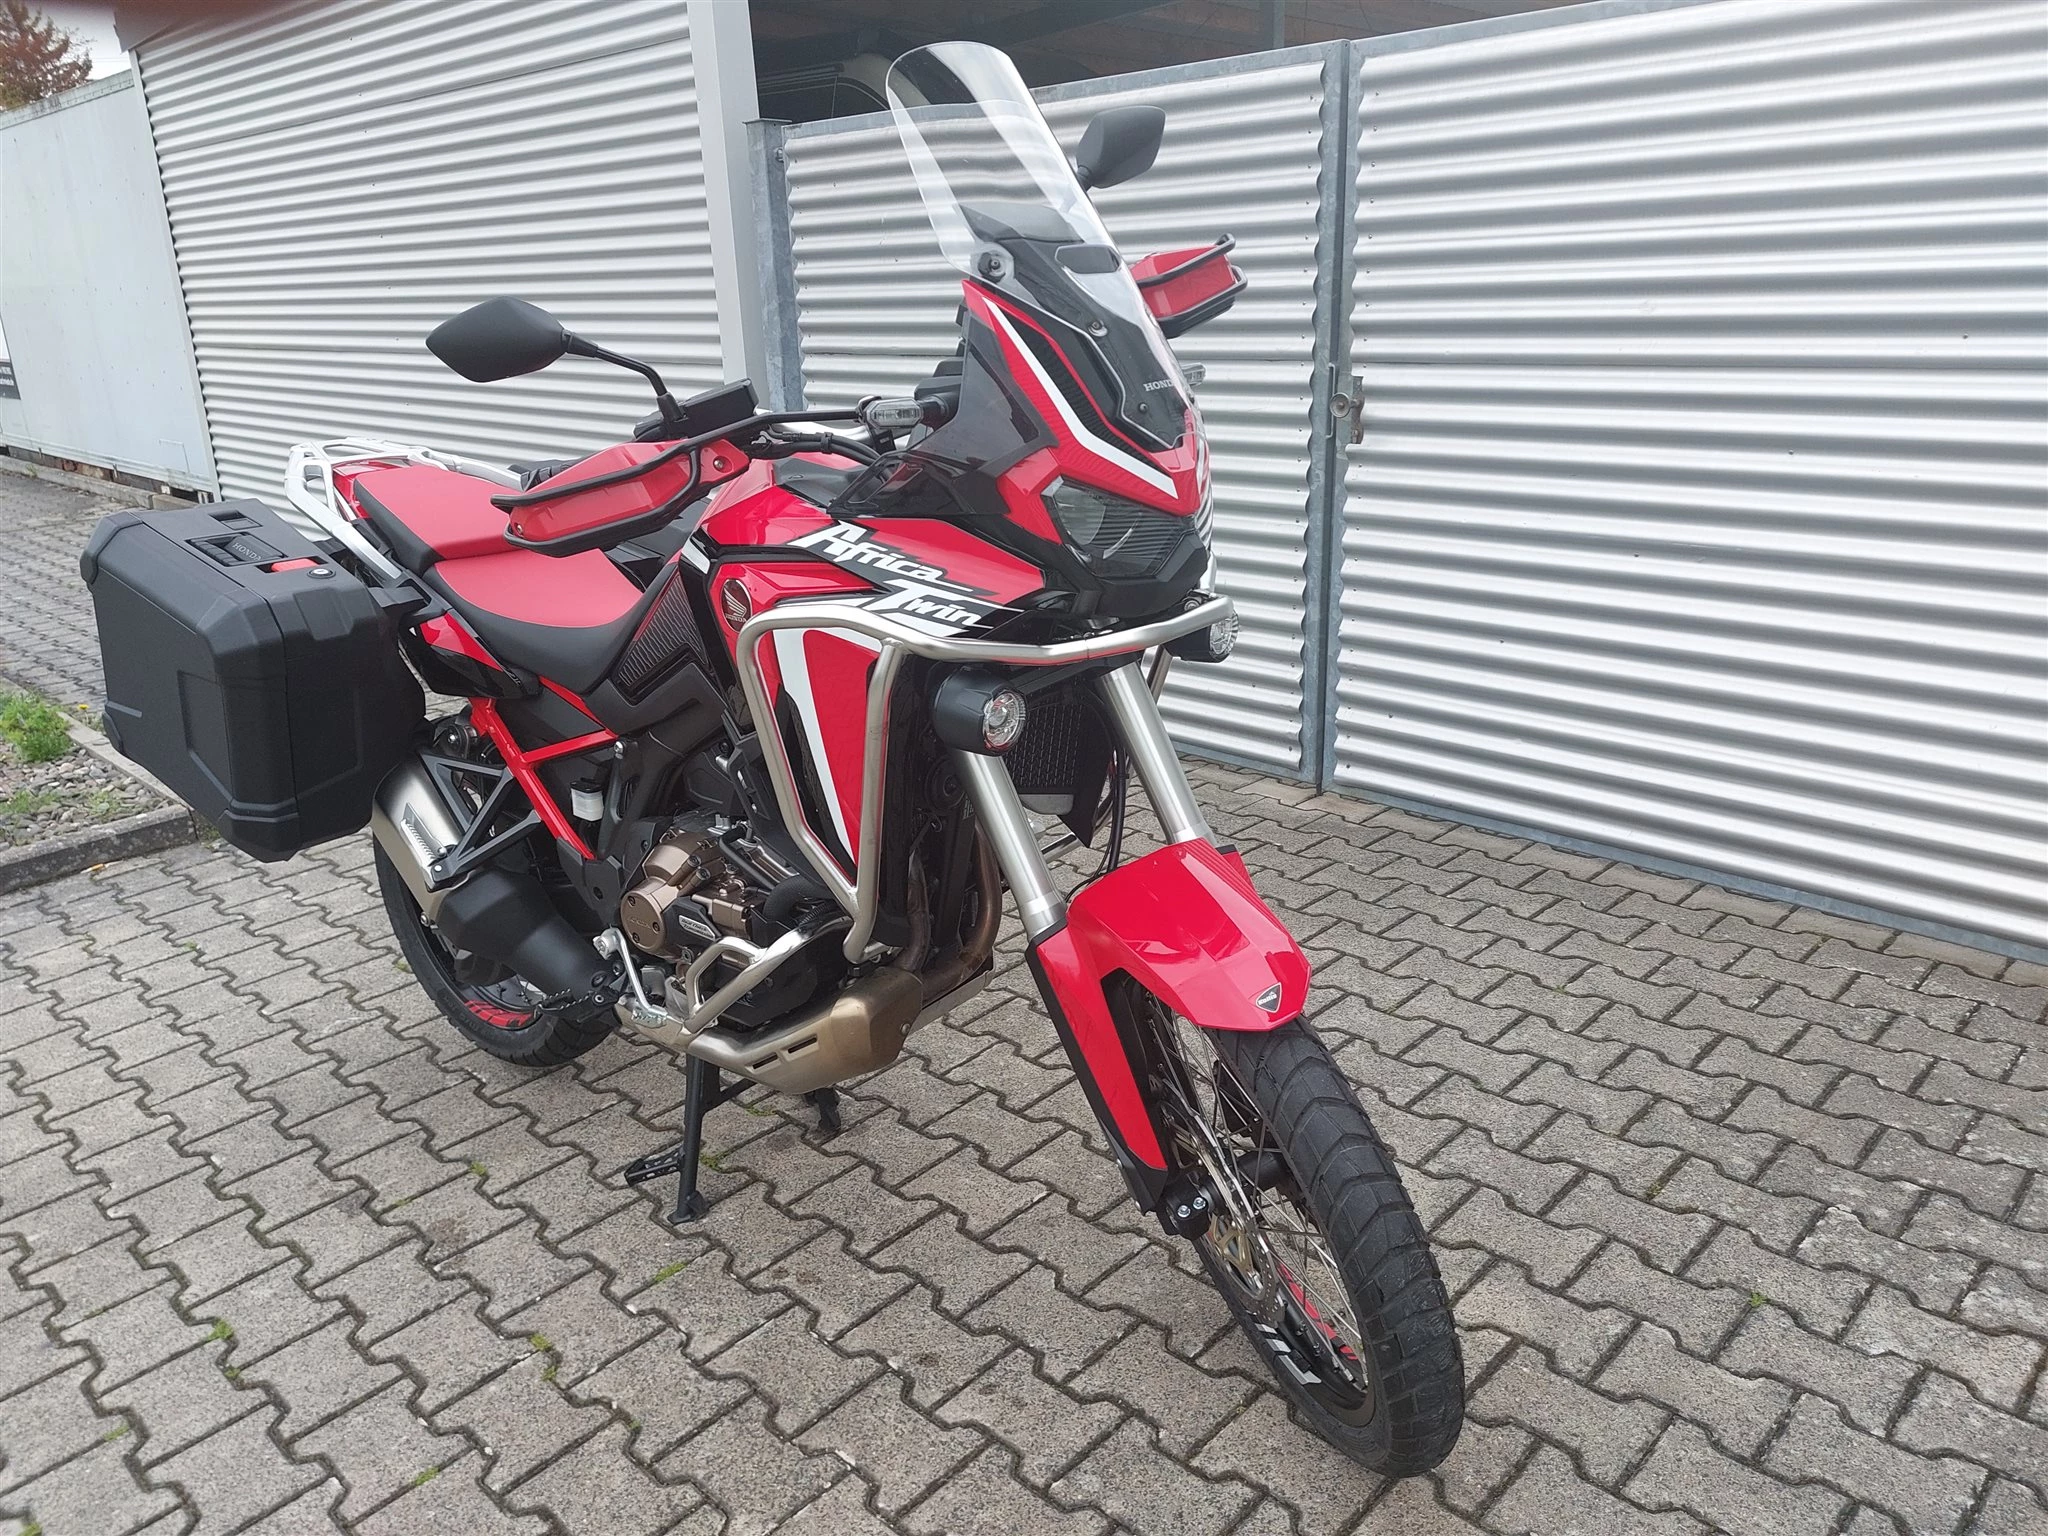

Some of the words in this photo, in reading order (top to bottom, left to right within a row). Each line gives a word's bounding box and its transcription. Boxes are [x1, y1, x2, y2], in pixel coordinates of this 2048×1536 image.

[1143, 380, 1174, 391] HOND
[232, 542, 262, 561] HONDA
[787, 519, 973, 592] Africa
[862, 578, 1000, 629] Twin
